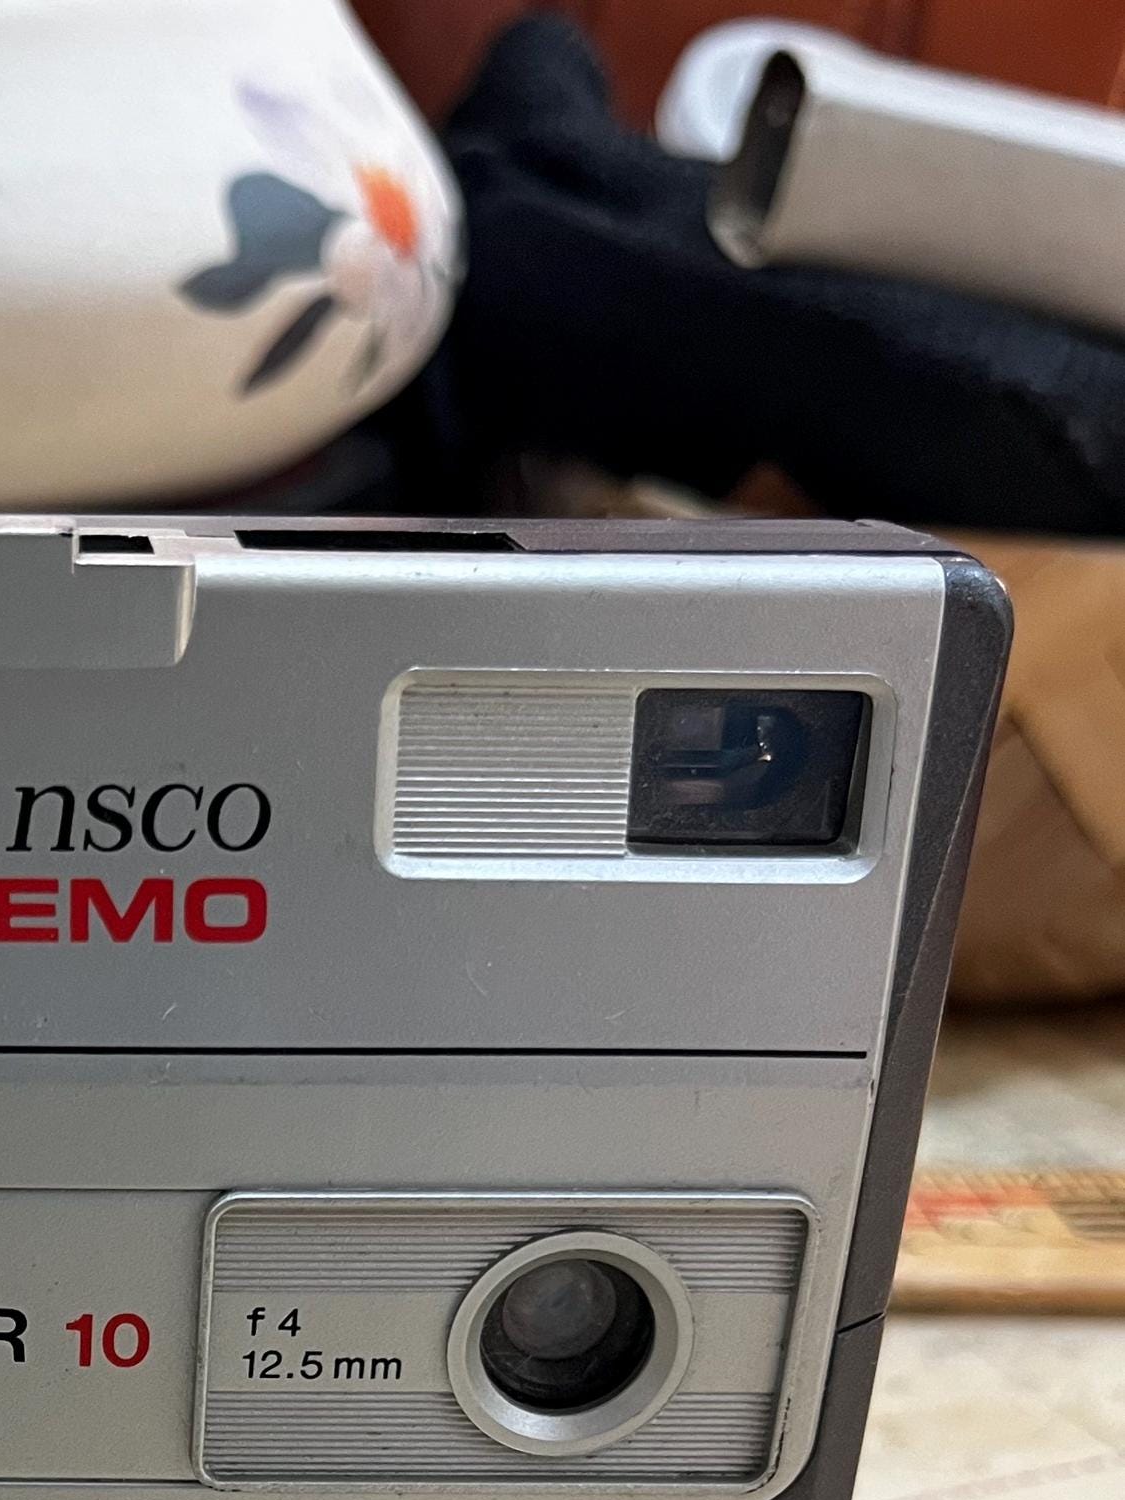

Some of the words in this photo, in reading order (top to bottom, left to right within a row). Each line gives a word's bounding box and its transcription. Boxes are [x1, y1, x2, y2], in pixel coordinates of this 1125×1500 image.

[65, 1313, 151, 1367] 10
[244, 1350, 324, 1381] 12.5
[333, 1356, 403, 1381] mm
